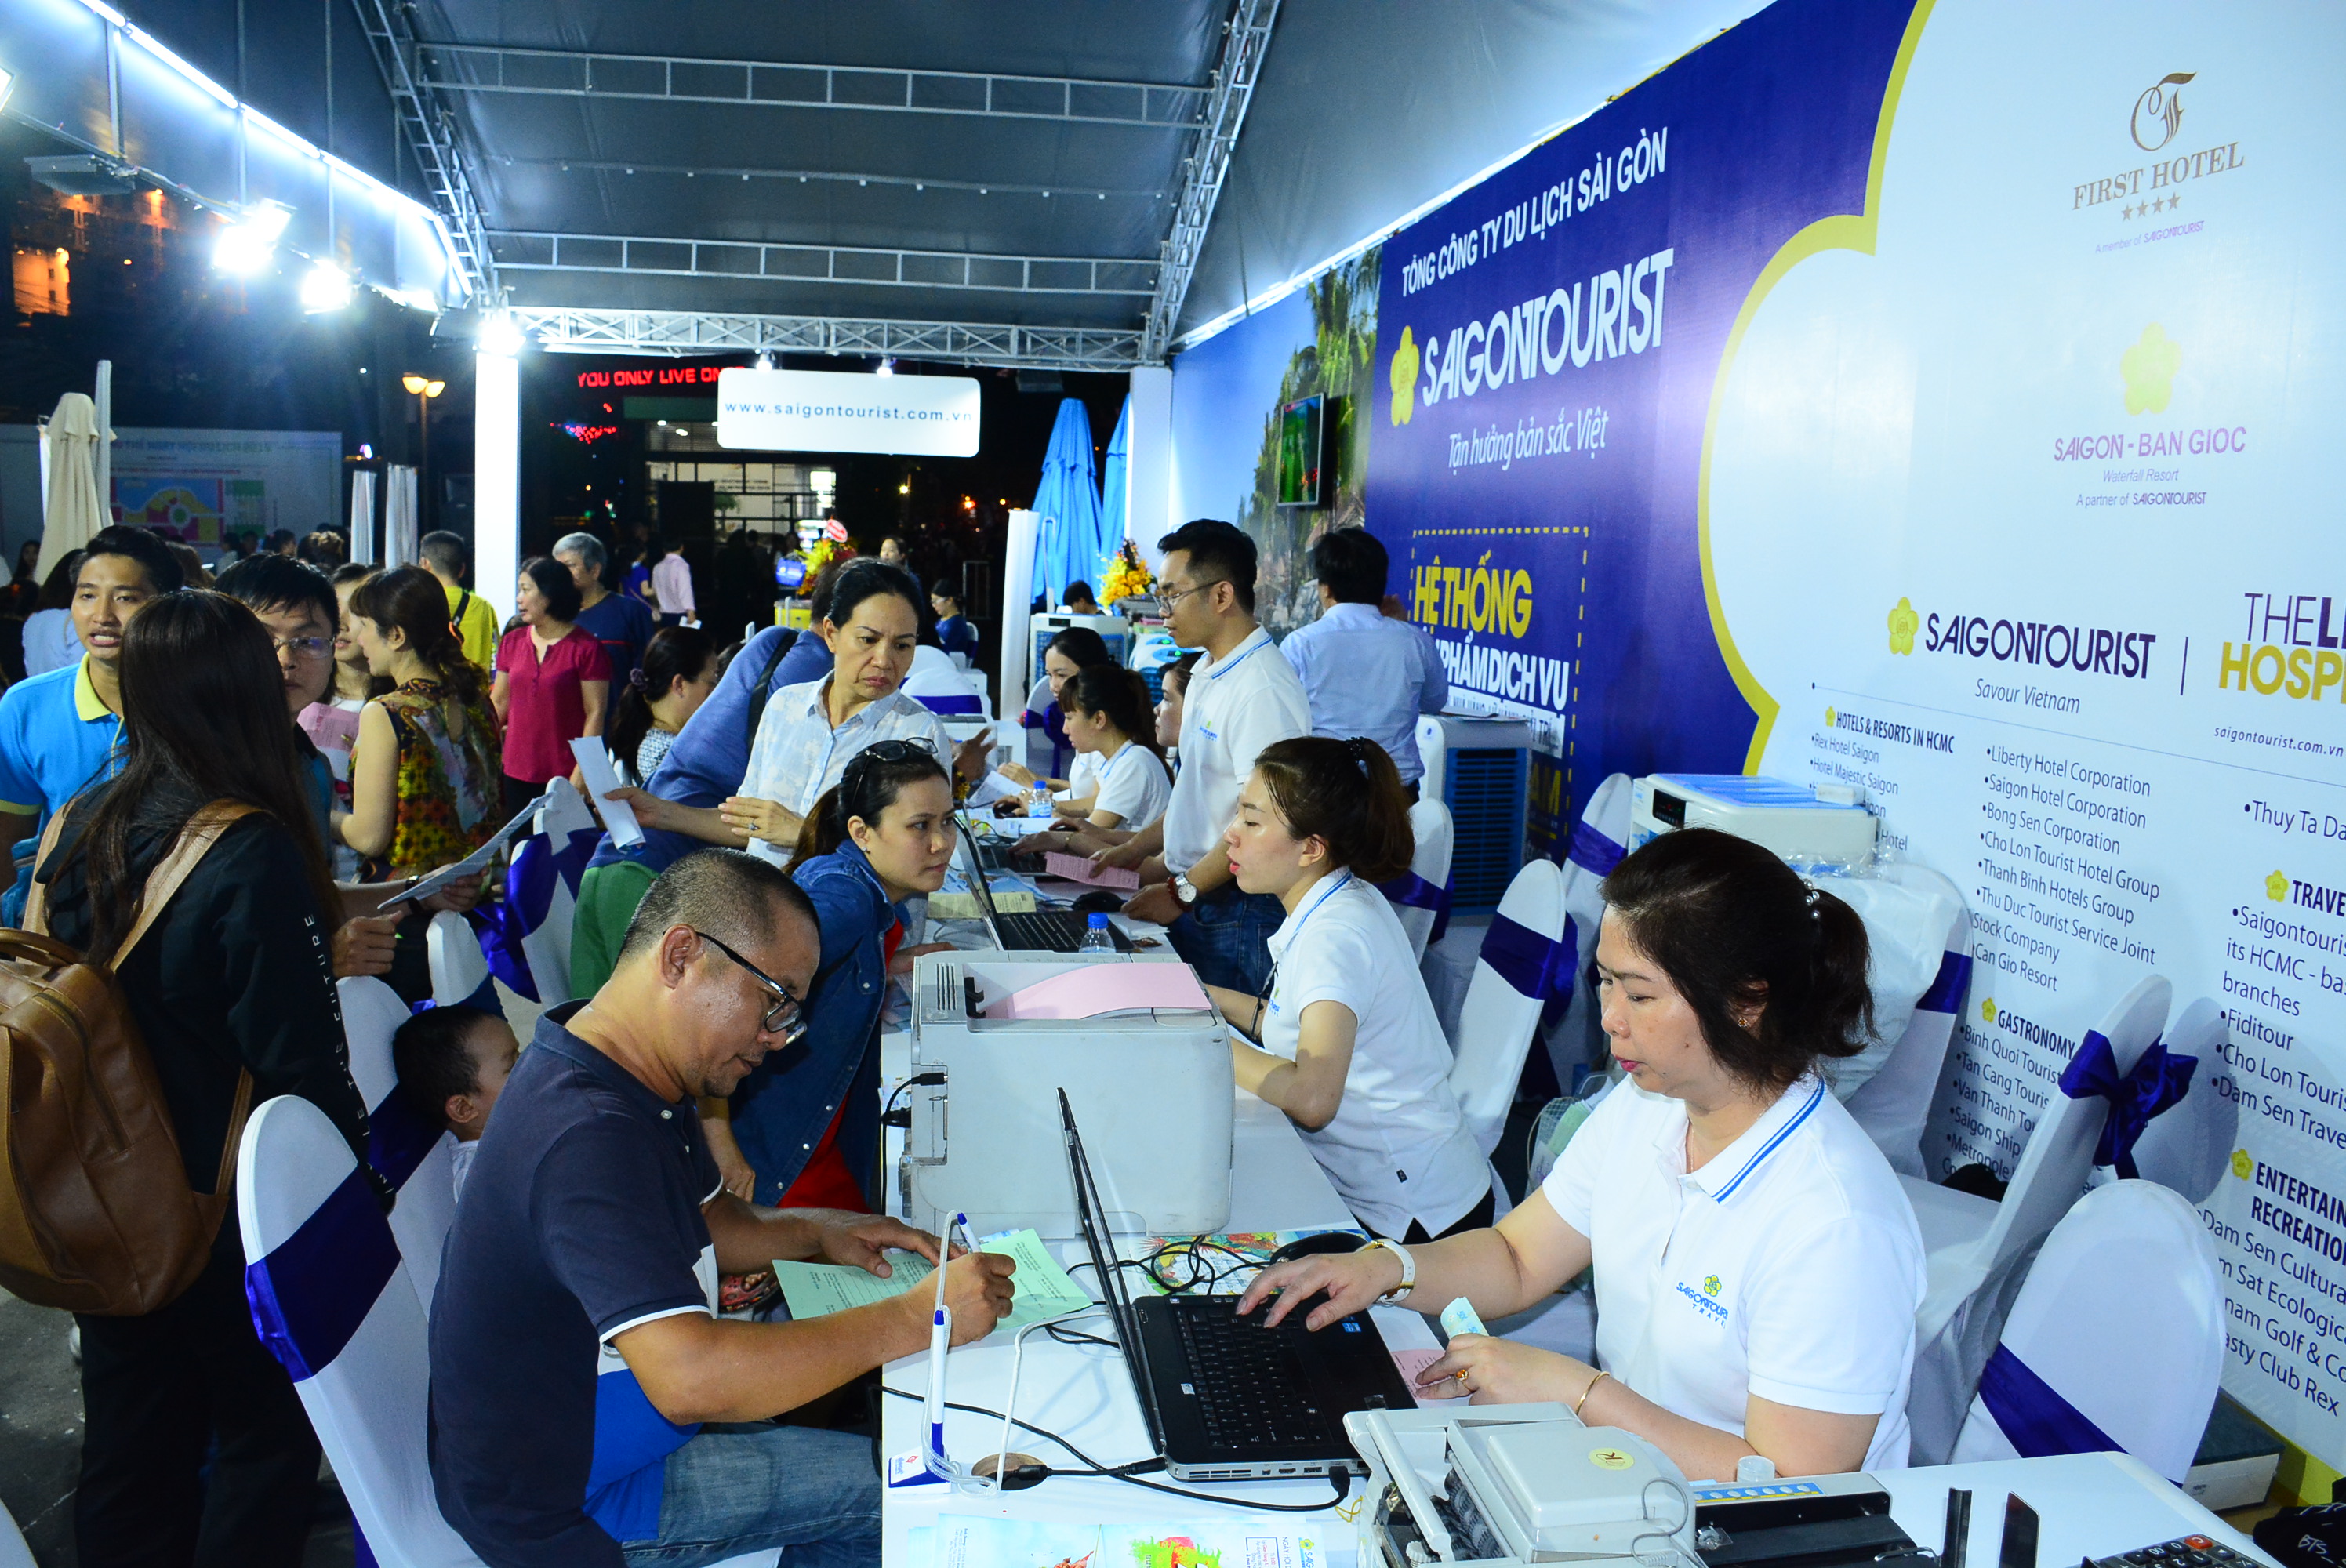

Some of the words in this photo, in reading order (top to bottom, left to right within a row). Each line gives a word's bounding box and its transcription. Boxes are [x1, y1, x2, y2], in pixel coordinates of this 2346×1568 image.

[2072, 169, 2144, 210] FIRST
[2150, 141, 2245, 190] HOTEL
[1403, 254, 1434, 297] TỔNG
[1438, 233, 1477, 280] CÔNG
[1482, 216, 1502, 256] TY
[1504, 201, 1527, 249] DU
[1531, 178, 1573, 240] LỊCH
[1578, 152, 1612, 212] SÀI
[1618, 127, 1668, 193] GÒN
[2095, 244, 2101, 254] A
[2102, 237, 2133, 253] member
[2134, 234, 2142, 245] of
[2144, 220, 2205, 244] SAIGONTOURIST
[1422, 248, 1673, 407] SAIGONTOURIST
[578, 372, 610, 387] YOU
[613, 370, 654, 386] ONLY
[659, 368, 697, 384] LIVE
[725, 401, 972, 422] www.saigontourist.com.vn
[1448, 433, 1469, 475] Tận
[1471, 424, 1512, 470] hưởng
[1515, 416, 1544, 459] bản
[1547, 407, 1573, 455] sắc
[1576, 405, 1609, 459] Việt
[2054, 434, 2124, 462] SAIGON
[2138, 430, 2183, 457] BAN
[2188, 426, 2247, 455] GIOC
[2076, 494, 2083, 506] A
[2085, 495, 2117, 508] partner
[2119, 493, 2129, 506] of
[2132, 492, 2206, 506] SAIGONTOURIST
[2103, 469, 2144, 483] Waterfall
[2146, 468, 2179, 482] Resort
[1925, 612, 2156, 679] SAIGONTOURIST
[1975, 678, 2020, 704] Savour
[2024, 685, 2080, 714] Vietnam
[2218, 641, 2346, 705] HOSP
[1814, 733, 1828, 750] Rex
[1829, 737, 1850, 755] Hotel
[1851, 742, 1879, 764] Saigon
[1836, 711, 1864, 733] HOTELS
[1865, 718, 1871, 735] &
[1873, 720, 1911, 744] RESORTS
[1913, 728, 1924, 747] IN
[1927, 731, 1955, 753] HCMC
[2213, 725, 2344, 757] saigontourist.com.vn
[1814, 757, 1833, 775] Hotel
[1835, 764, 1865, 785] Majestic
[1868, 773, 1898, 795] Saigon
[1992, 746, 2032, 773] Liberty
[2035, 755, 2068, 777] Hotel
[2070, 762, 2151, 797] Corporation
[1989, 774, 2028, 802] Saigon
[2031, 784, 2064, 807] Hotel
[2066, 793, 2147, 829] Corporation
[2253, 800, 2295, 833] Thuy
[2299, 810, 2317, 834] Ta
[1881, 829, 1908, 851] Hotel
[1987, 802, 2017, 829] Bong
[2019, 811, 2041, 832] Sen
[2044, 817, 2120, 855] Corporation
[1985, 830, 2008, 853] Cho
[2010, 837, 2032, 858] Lon
[2034, 843, 2074, 873] Tourist
[2077, 860, 2112, 886] Hotel
[2115, 870, 2160, 902] Group
[1983, 858, 2017, 885] Thanh
[2020, 868, 2046, 895] Binh
[2050, 877, 2089, 909] Hotels
[2092, 891, 2134, 927] Group
[2293, 880, 2346, 917] TRAVE
[1973, 913, 2002, 939] Stock
[2004, 925, 2060, 964] Company
[1981, 887, 2001, 910] Thu
[2004, 895, 2026, 918] Duc
[2028, 903, 2069, 936] Tourist
[2072, 918, 2118, 952] Service
[2121, 938, 2156, 966] Joint
[2240, 906, 2346, 957] Saigontouris
[1975, 943, 1996, 965] Can
[1999, 950, 2017, 972] Gio
[2020, 960, 2057, 992] Resort
[2227, 938, 2245, 960] its
[2250, 945, 2304, 980] HCMC
[2321, 966, 2346, 996] bas
[2223, 971, 2300, 1016] branches
[1965, 1025, 1988, 1050] Binh
[1992, 1038, 2019, 1065] Quoi
[2022, 1052, 2061, 1083] Tourist
[1998, 1010, 2075, 1060] GASTRONOMY
[2228, 1008, 2293, 1051] Fiditour
[1958, 1078, 1977, 1104] Van
[1981, 1090, 2015, 1123] Thanh
[1962, 1051, 1980, 1076] Tan
[1983, 1064, 2011, 1095] Cang
[2015, 1077, 2049, 1110] Touris
[2223, 1044, 2256, 1073] Cho
[2261, 1058, 2292, 1088] Lon
[2298, 1071, 2346, 1112] Touris
[1955, 1106, 1992, 1141] Saigon
[1995, 1128, 2021, 1158] Ship
[2219, 1076, 2257, 1110] Dam
[2261, 1095, 2293, 1127] Sen
[2300, 1109, 2346, 1149] Trave
[2256, 1162, 2346, 1228] ENTERTAIN
[2251, 1196, 2346, 1266] RECREATIO
[2203, 1209, 2239, 1246] Dam
[2244, 1232, 2275, 1265] Sen
[2281, 1252, 2346, 1305] Cultura
[2237, 1265, 2264, 1295] Sat
[2268, 1280, 2346, 1344] Ecologic
[2265, 1318, 2305, 1355] Golf
[2307, 1342, 2321, 1367] &
[2259, 1351, 2300, 1391] Club
[2305, 1377, 2340, 1417] Rex
